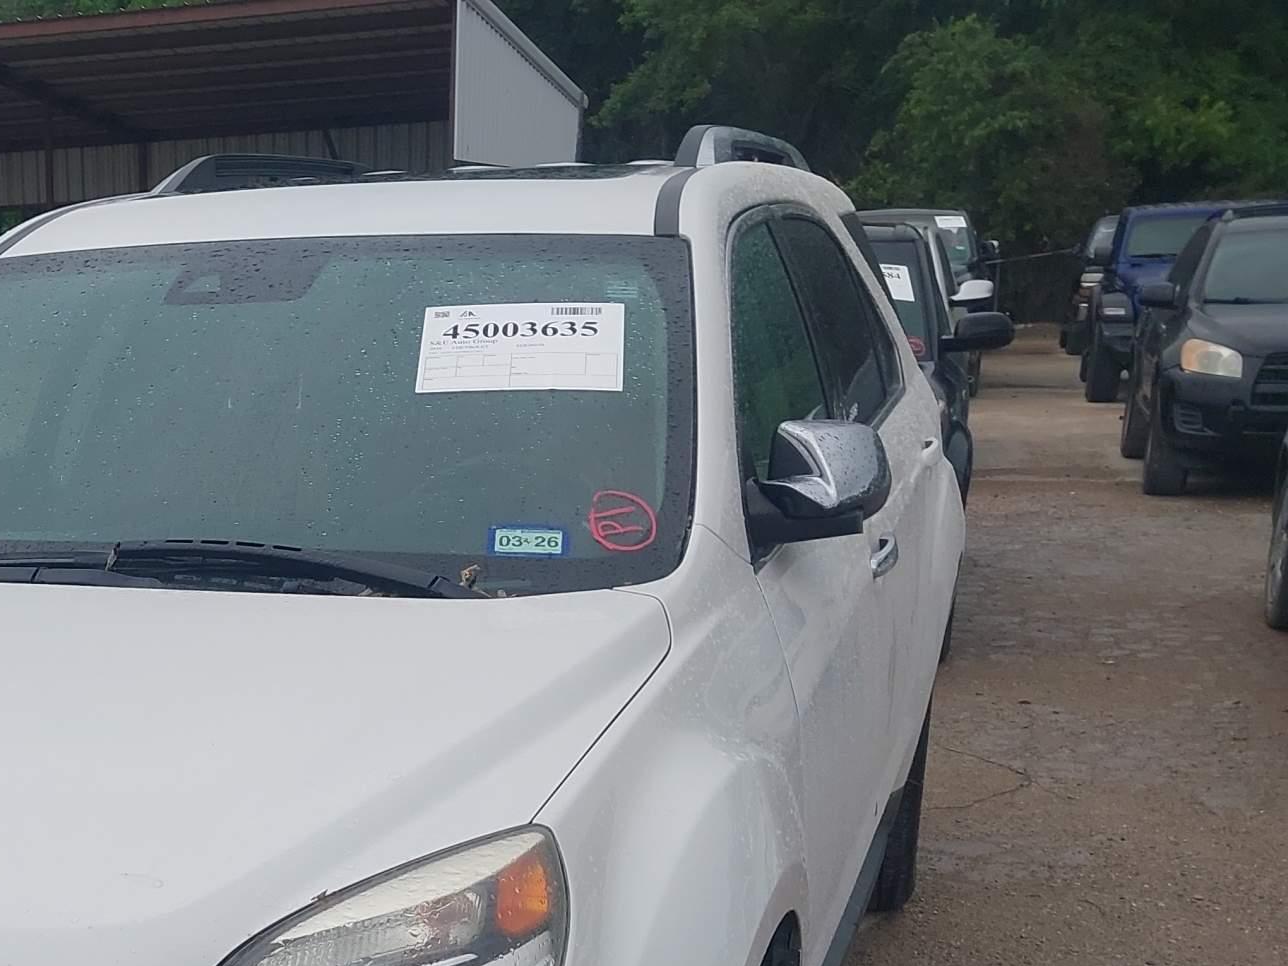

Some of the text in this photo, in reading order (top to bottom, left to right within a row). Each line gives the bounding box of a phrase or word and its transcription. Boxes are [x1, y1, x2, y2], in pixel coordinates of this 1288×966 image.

[442, 321, 599, 339] 45003635
[498, 535, 559, 548] 03 26
